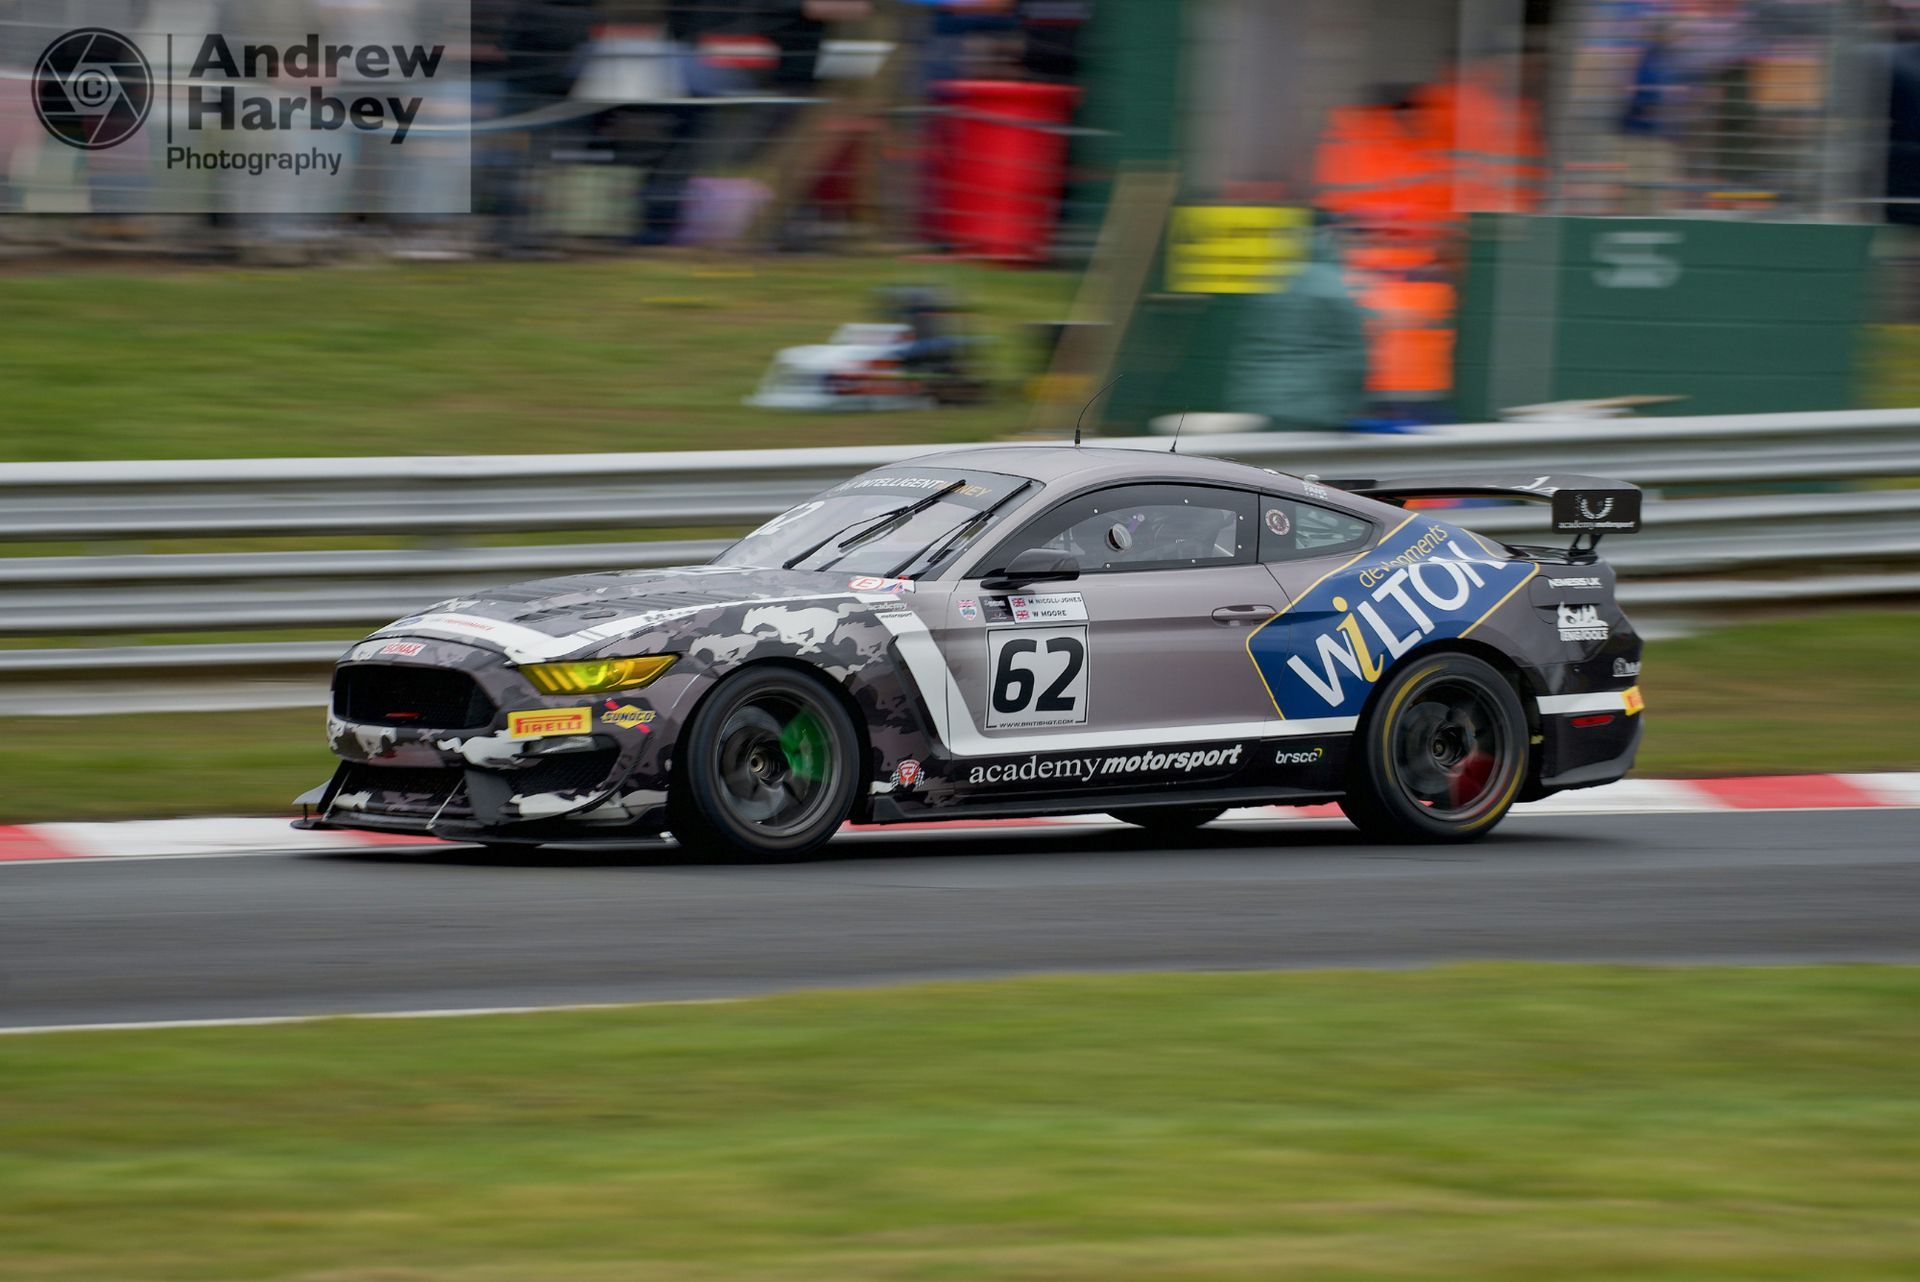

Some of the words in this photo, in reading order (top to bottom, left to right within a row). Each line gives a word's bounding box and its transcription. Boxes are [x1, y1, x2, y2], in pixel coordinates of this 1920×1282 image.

[1042, 610, 1067, 619] MOORE
[992, 636, 1085, 714] 62
[514, 713, 582, 735] PIRELLI
[601, 710, 655, 725] SUNOCO
[968, 756, 1101, 784] academy
[1100, 743, 1244, 776] motorsport
